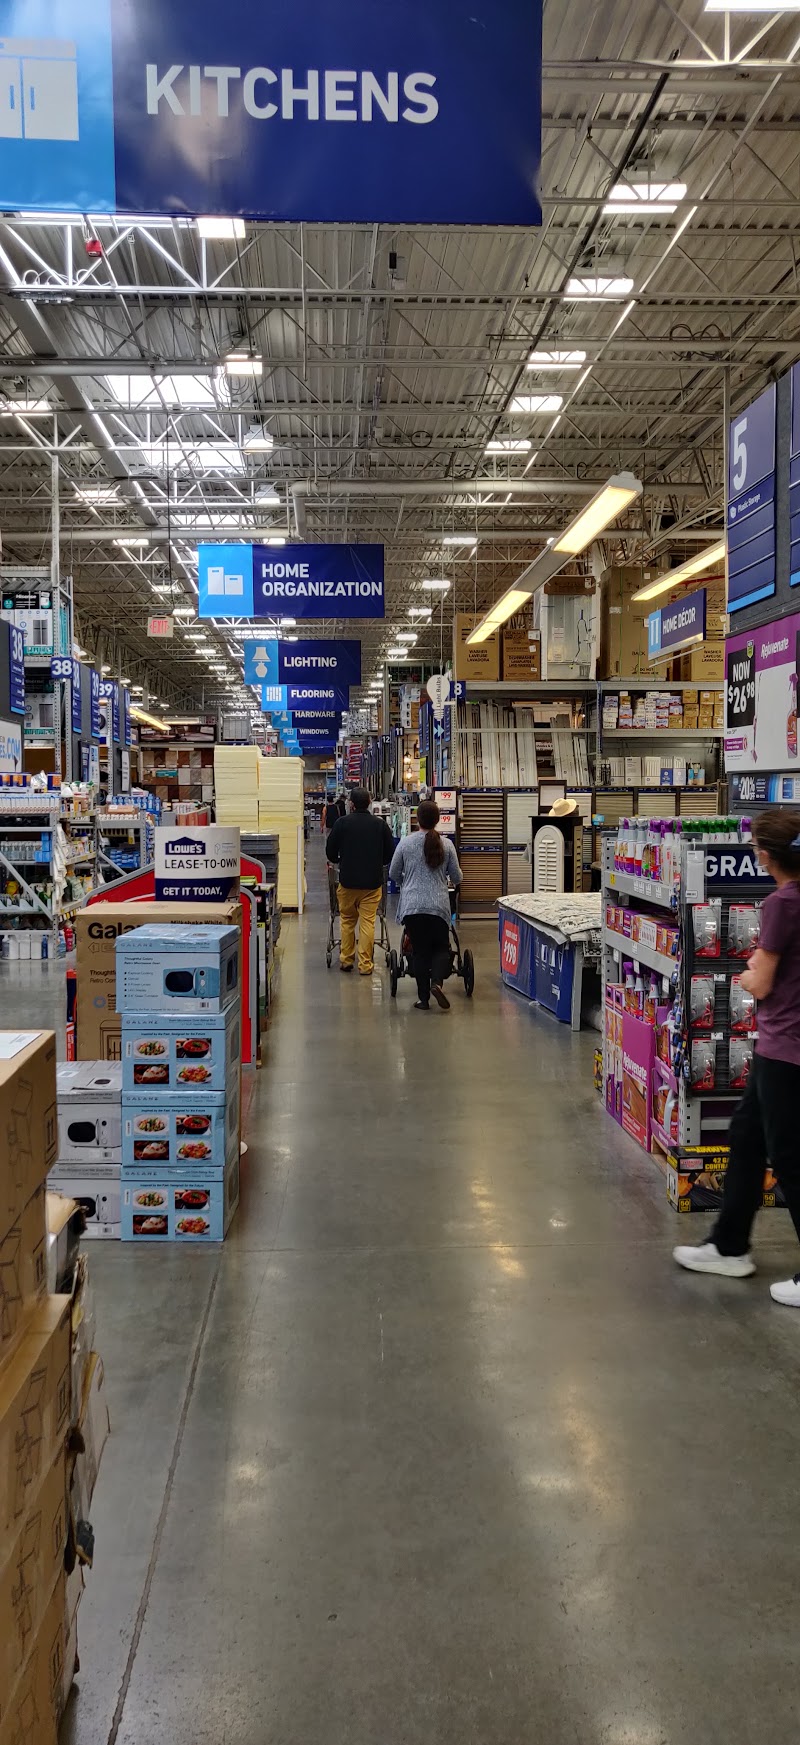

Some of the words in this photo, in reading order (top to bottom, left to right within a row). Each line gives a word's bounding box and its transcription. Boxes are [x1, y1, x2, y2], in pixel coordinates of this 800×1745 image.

[145, 63, 440, 125] KITCHENS
[733, 416, 748, 491] 5
[737, 501, 748, 513] Plastic
[261, 563, 310, 578] HOME
[261, 581, 383, 597] ORGANIZATION
[151, 619, 168, 635] EXIT
[662, 614, 678, 635] HOME
[677, 607, 696, 629] DÉCOR
[12, 628, 23, 662] 38
[760, 637, 790, 660] Rejuvenate
[51, 659, 73, 676] 38
[283, 656, 338, 668] LIGHTING
[732, 660, 751, 683] NOW
[99, 683, 113, 696] 39
[291, 689, 335, 698] FLOORING
[453, 682, 463, 696] 8
[382, 735, 390, 743] 12
[395, 727, 403, 736] 11
[168, 843, 203, 854] LOWE'S
[164, 857, 238, 869] LEASE-TO-OWN
[162, 886, 180, 896] GET
[181, 887, 191, 896] IT
[193, 886, 223, 896] TODAY,
[87, 922, 141, 940] Gala
[622, 1051, 648, 1081] Rejuvenate
